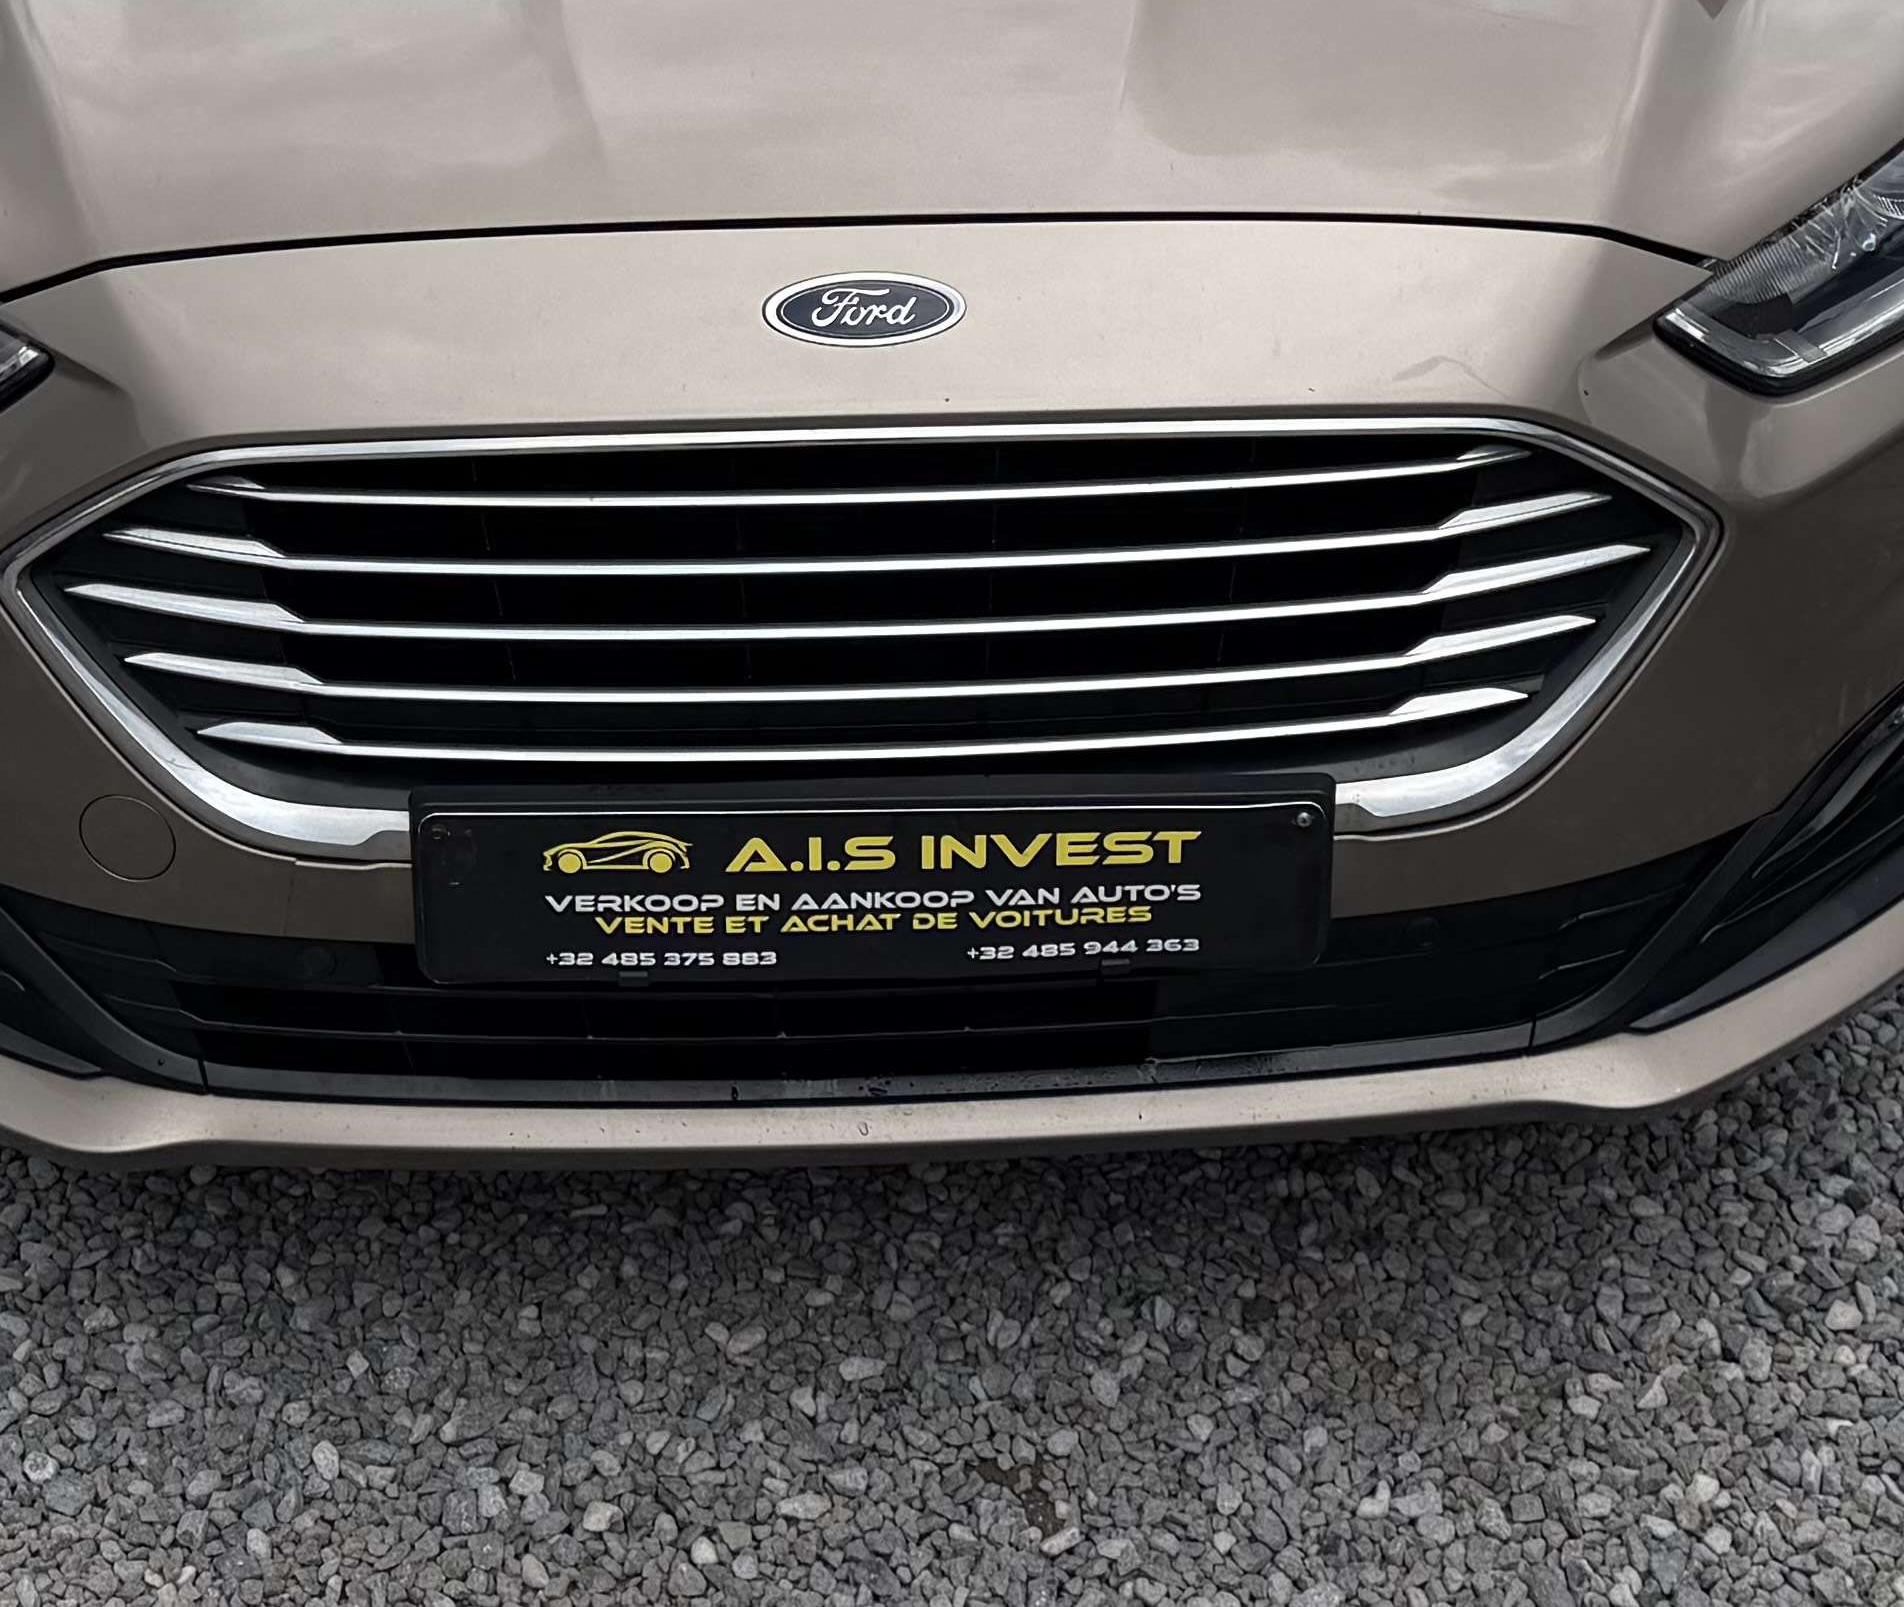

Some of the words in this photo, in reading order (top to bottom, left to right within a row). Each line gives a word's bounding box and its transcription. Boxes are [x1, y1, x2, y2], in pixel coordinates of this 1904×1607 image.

[811, 287, 917, 327] Ford
[724, 835, 896, 873] A.I.S
[921, 831, 1202, 869] INVEST
[544, 894, 725, 913] VERKOOP
[735, 893, 780, 912] EN
[791, 890, 975, 911] AANKOOP
[985, 887, 1061, 907] VAN
[1070, 884, 1202, 905] AUTO'S
[595, 915, 715, 935] VENTE
[725, 915, 770, 934] ET
[780, 912, 902, 933] ACHAT
[912, 912, 958, 930] DE
[969, 905, 1153, 930] VOITURES
[546, 952, 594, 966] +32
[600, 951, 656, 966] 485
[663, 951, 716, 966] 375
[966, 945, 1016, 961] +32
[1021, 942, 1076, 958] 485
[1083, 940, 1139, 955] 944
[1145, 938, 1201, 953] 363
